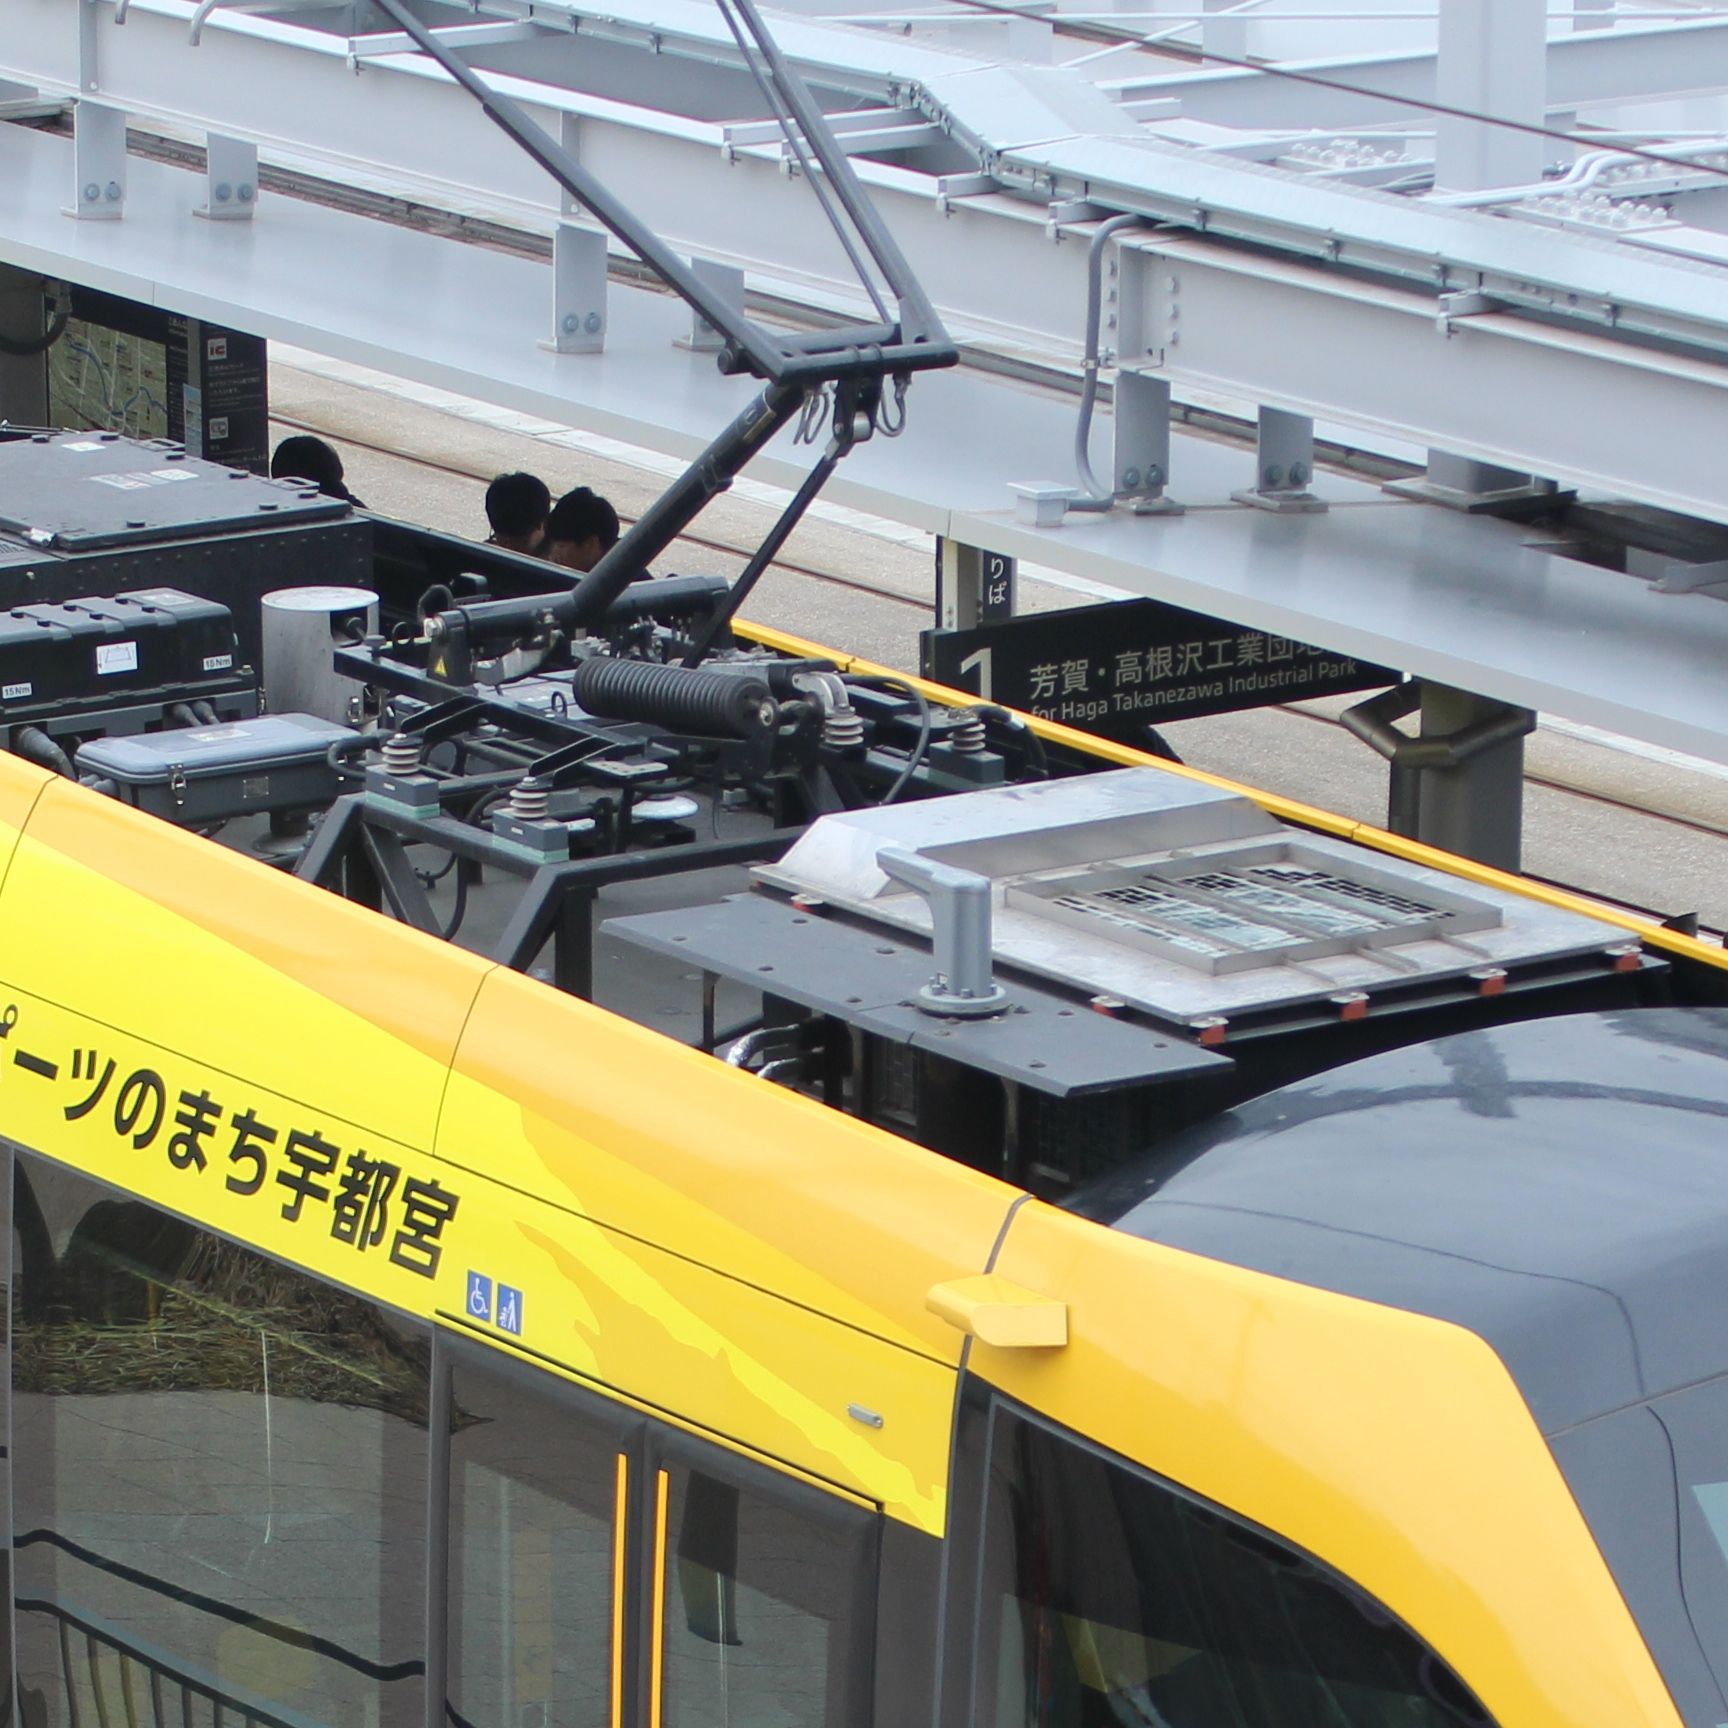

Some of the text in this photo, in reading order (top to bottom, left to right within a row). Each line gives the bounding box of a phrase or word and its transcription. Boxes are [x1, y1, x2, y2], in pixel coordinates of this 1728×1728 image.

[960, 647, 992, 701] 1
[1061, 700, 1109, 722] Haga
[1112, 683, 1224, 711] Takanezawa
[1228, 669, 1313, 694] Industrial
[1318, 660, 1357, 681] Park
